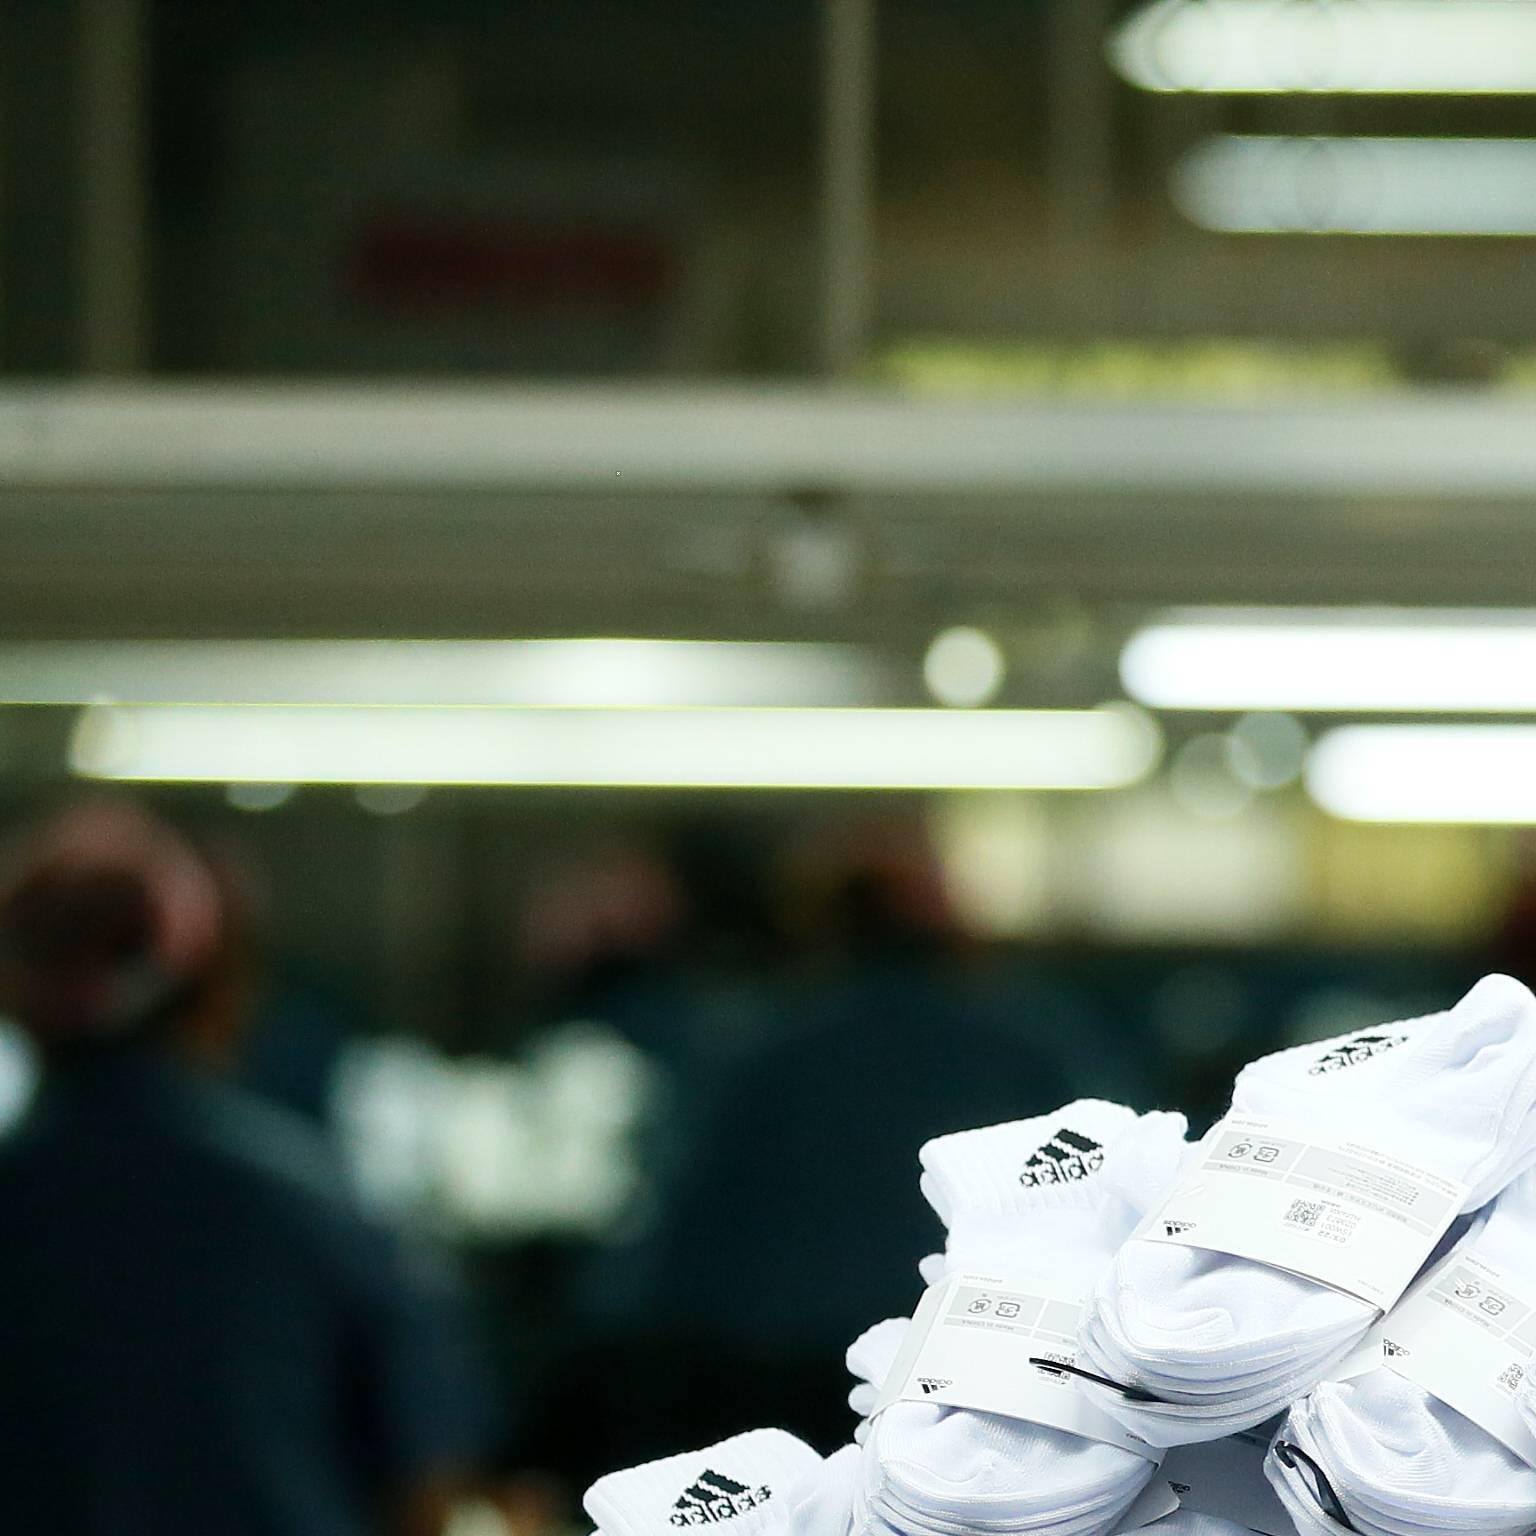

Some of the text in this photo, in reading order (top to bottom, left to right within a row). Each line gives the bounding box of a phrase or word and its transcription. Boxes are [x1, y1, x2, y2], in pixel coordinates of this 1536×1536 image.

[1308, 1035, 1409, 1076] adidas
[1020, 1151, 1104, 1188] adida
[670, 1485, 773, 1528] adidas
